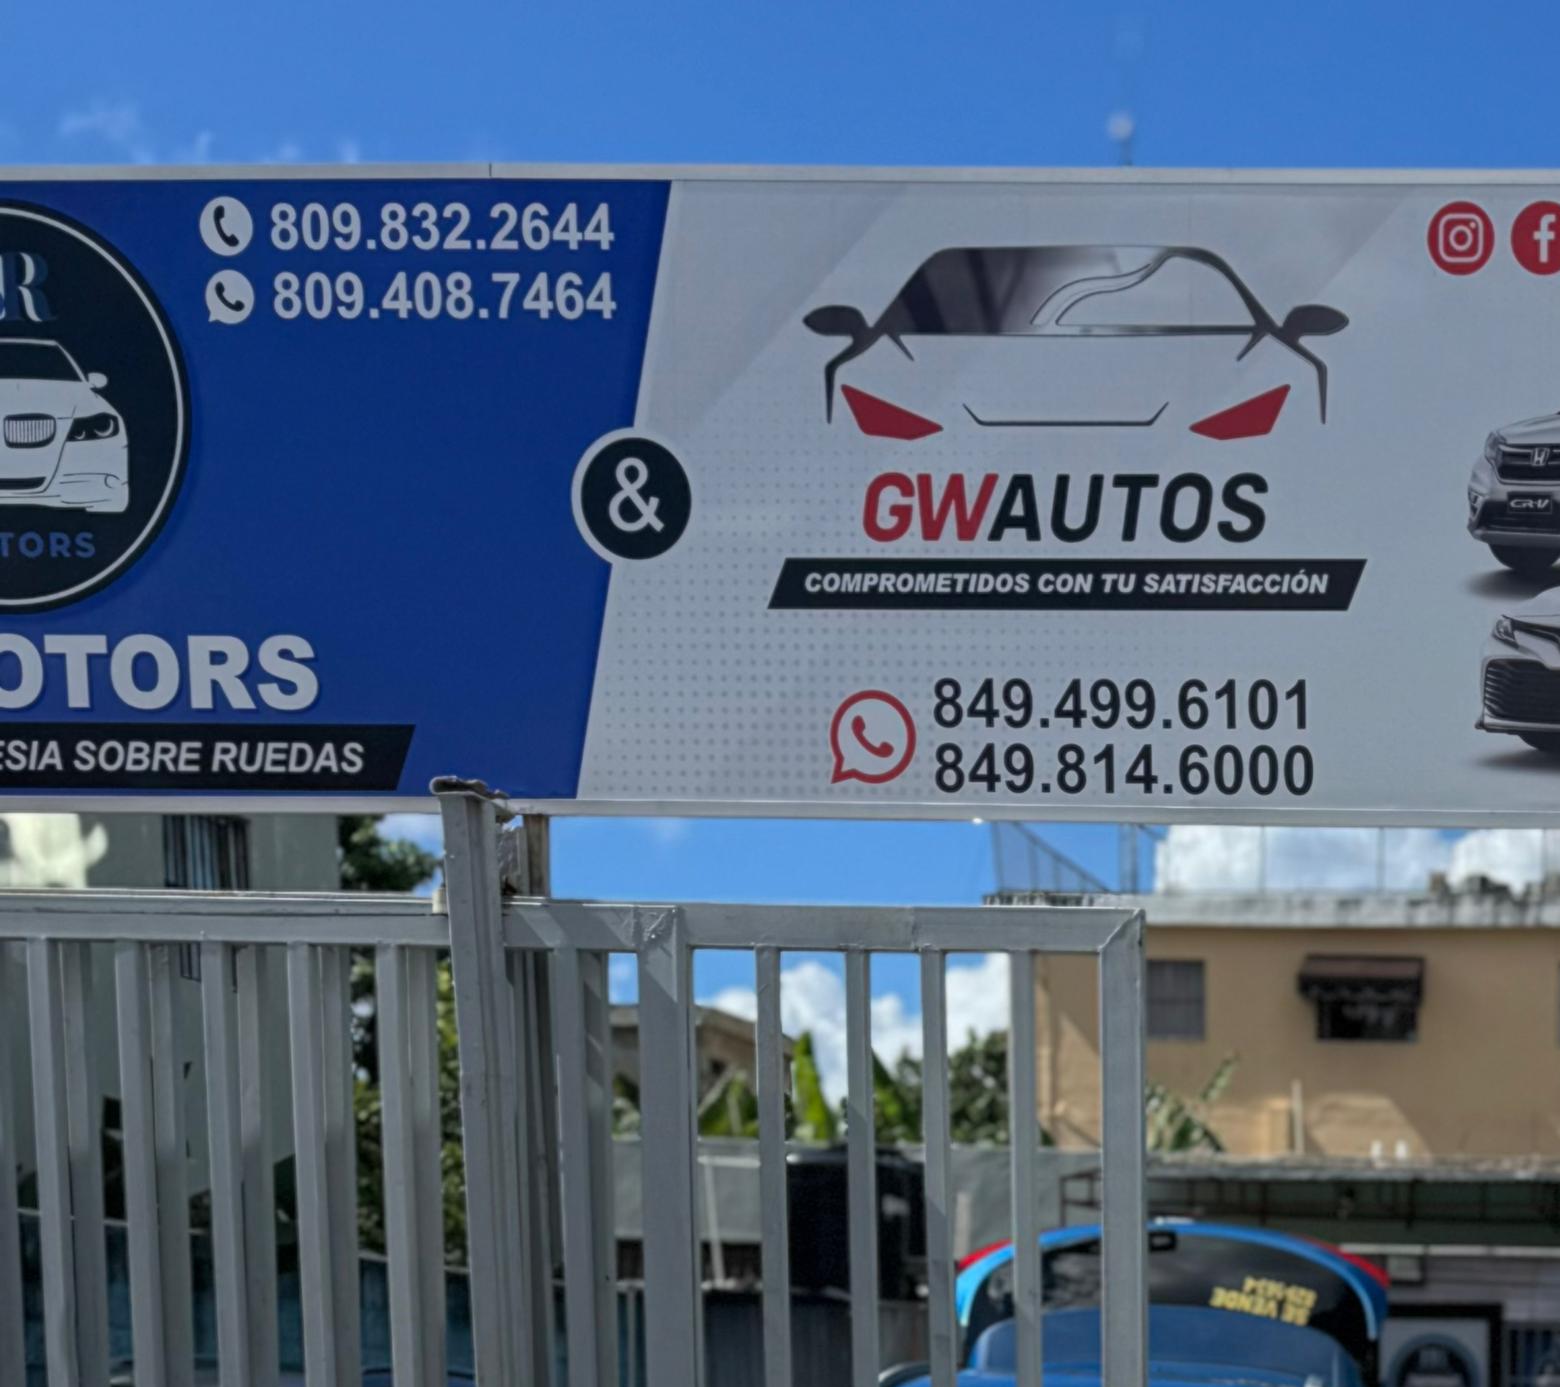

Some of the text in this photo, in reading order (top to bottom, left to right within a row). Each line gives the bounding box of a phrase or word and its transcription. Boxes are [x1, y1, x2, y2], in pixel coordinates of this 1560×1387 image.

[271, 203, 614, 251] 809.832.2644
[273, 272, 617, 319] 809.408.7464
[608, 457, 664, 532] &
[862, 472, 1270, 543] GWAUTOS
[804, 568, 1329, 595] COMPROMETIDOS CON TU SATISFACCIÓN
[932, 677, 1309, 730] 849.499.6101
[73, 740, 201, 772] SOBRE
[212, 740, 364, 773] RUEDAS
[934, 743, 1314, 796] 849.814.6000
